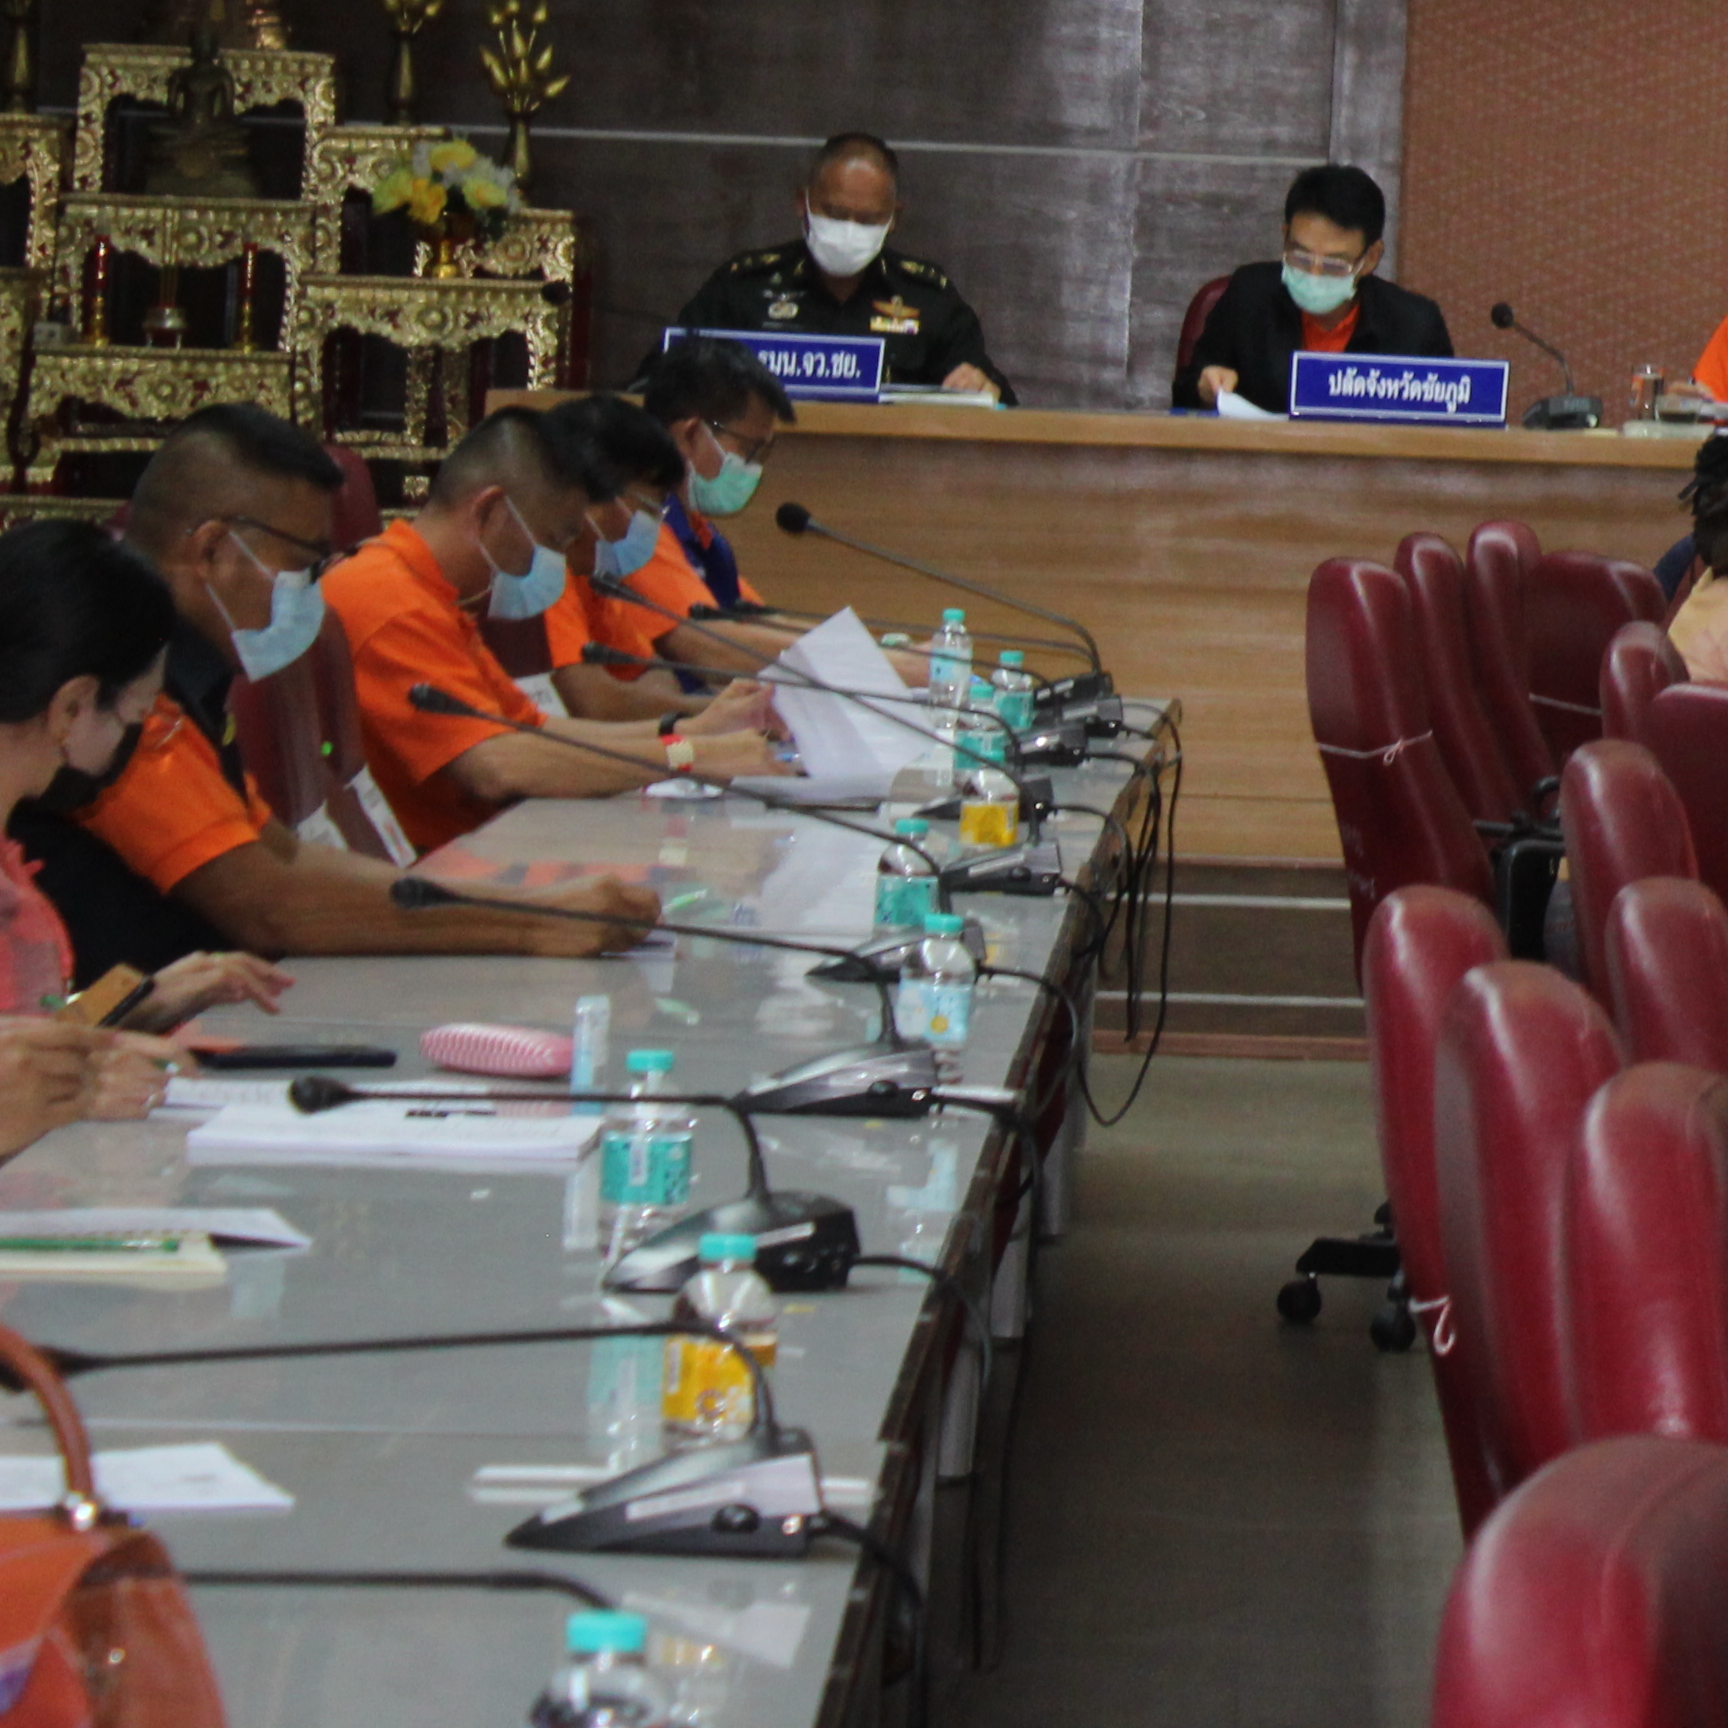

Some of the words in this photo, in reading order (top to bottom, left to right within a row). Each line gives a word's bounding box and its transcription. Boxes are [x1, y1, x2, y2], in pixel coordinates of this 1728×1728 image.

[1328, 366, 1472, 413] ปลัดจังหวัดชัยภูมิ
